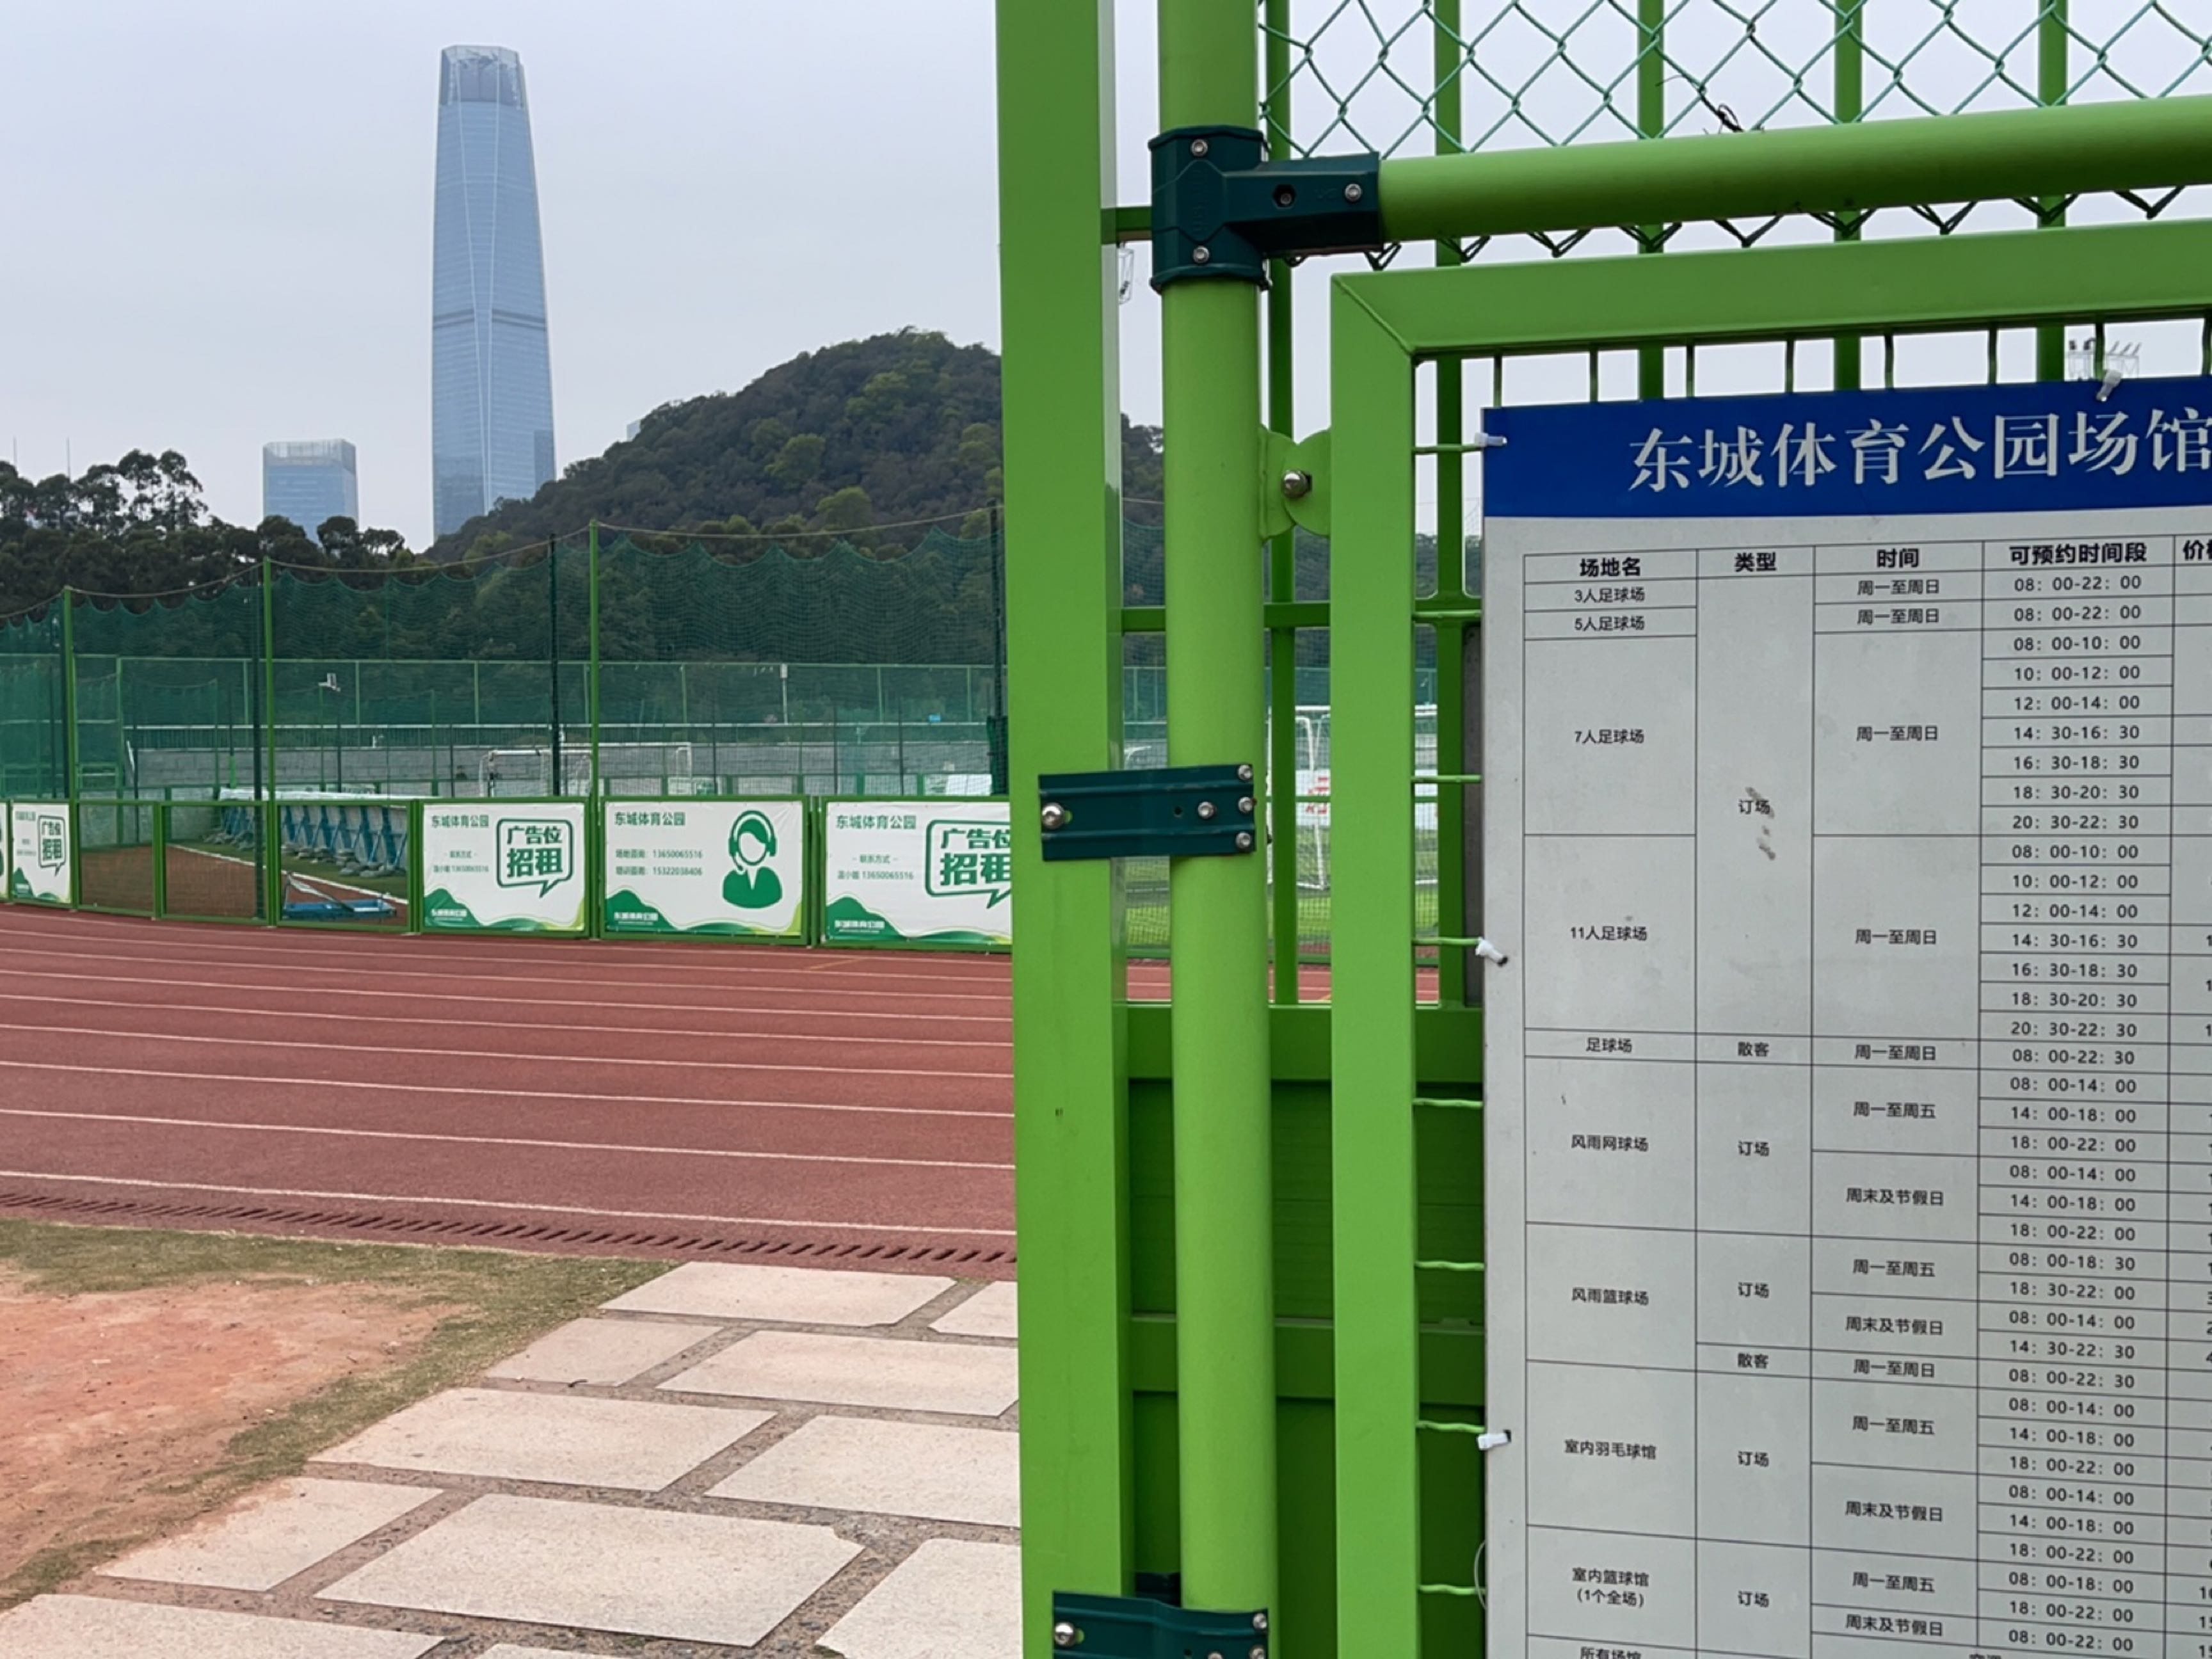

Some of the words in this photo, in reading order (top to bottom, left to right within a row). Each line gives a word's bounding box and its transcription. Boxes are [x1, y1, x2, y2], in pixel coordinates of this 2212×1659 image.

[1628, 406, 2212, 492] 东城体育公园场馆
[1733, 551, 1777, 573] 类型
[1876, 547, 1920, 568] 时间
[2008, 542, 2147, 565] 可预约时间段
[1579, 556, 1641, 578] 场地名
[1574, 586, 1646, 604] 3人足球场
[1857, 579, 1939, 596] 周一至周日
[1574, 615, 1646, 632] 5人足球场
[1857, 608, 1939, 626] 周一至周日
[1575, 728, 1645, 744] 7人足球场
[1856, 725, 1938, 742] 周一至周日
[1738, 799, 1770, 815] 订场
[431, 815, 489, 828] 东城体育公园
[614, 812, 685, 826] 东城体育公园
[837, 815, 917, 830] 东城体育公园
[507, 826, 563, 844] 广告位
[941, 828, 1010, 849] 广告位
[507, 848, 563, 878] 招租
[940, 853, 1011, 885] 招租
[1570, 926, 1647, 942] 11人足球场
[1855, 929, 1937, 945] 周一至周日
[1585, 1036, 1633, 1054] 足球场
[1737, 1041, 1769, 1057] 散客
[1854, 1044, 1936, 1061] 周一至周日
[1853, 1101, 1936, 1119] 周一至周五
[1571, 1134, 1649, 1153] 风雨网球场
[1738, 1141, 1770, 1157] 订场
[1846, 1187, 1944, 1206] 周末及节假日
[1852, 1258, 1936, 1278] 周一至周五
[1571, 1286, 1649, 1306] 风雨篮球场
[1738, 1281, 1770, 1299] 订场
[1845, 1316, 1943, 1336] 周末及节假日
[1737, 1352, 1769, 1370] 散客
[1853, 1359, 1935, 1379] 周一至周日
[1852, 1415, 1935, 1436] 周一至周五
[1564, 1438, 1656, 1460] 室内羽毛球馆
[1737, 1450, 1769, 1468] 订场
[1845, 1500, 1943, 1523] 周末及节假日
[1572, 1566, 1649, 1587] 室内篮球馆
[1852, 1571, 1935, 1594] 周一至周五
[1738, 1591, 1770, 1608] 订场
[1845, 1614, 1943, 1637] 周末及节假日
